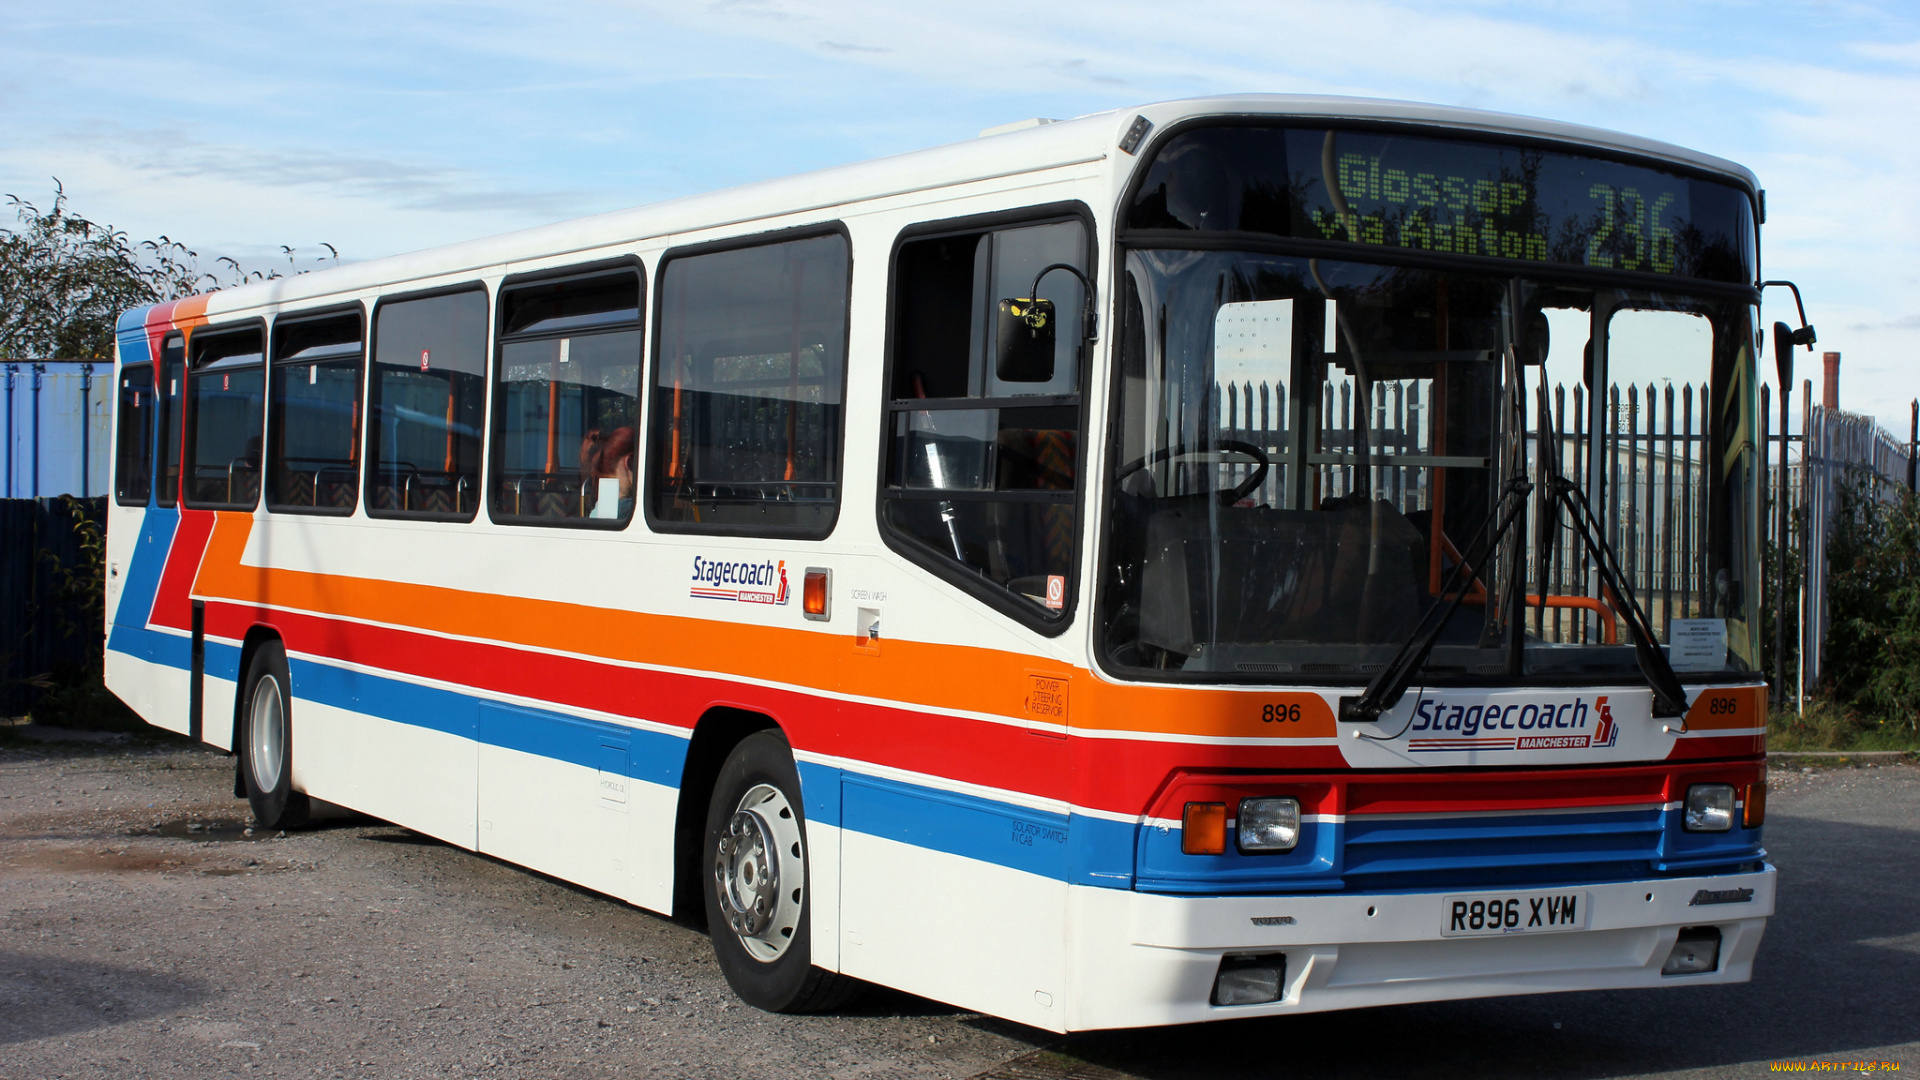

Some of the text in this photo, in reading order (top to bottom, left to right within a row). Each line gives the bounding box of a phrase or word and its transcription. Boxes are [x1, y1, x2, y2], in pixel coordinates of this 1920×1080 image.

[1339, 152, 1527, 216] Glossop
[1400, 209, 1548, 262] Ashton
[1588, 182, 1676, 274] 236
[691, 555, 774, 588] Stagecoach
[739, 592, 774, 604] MANCHESTER
[1035, 679, 1060, 692] POWER
[1033, 690, 1062, 706] STEERING
[1709, 697, 1737, 716] 896
[1262, 703, 1302, 724] 896
[1412, 698, 1588, 736] Stagecoach
[1519, 736, 1588, 750] MANCHESTER
[1012, 832, 1033, 846] IN CAB
[1042, 828, 1068, 844] SWITCH
[1451, 895, 1577, 931] R896 XVM
